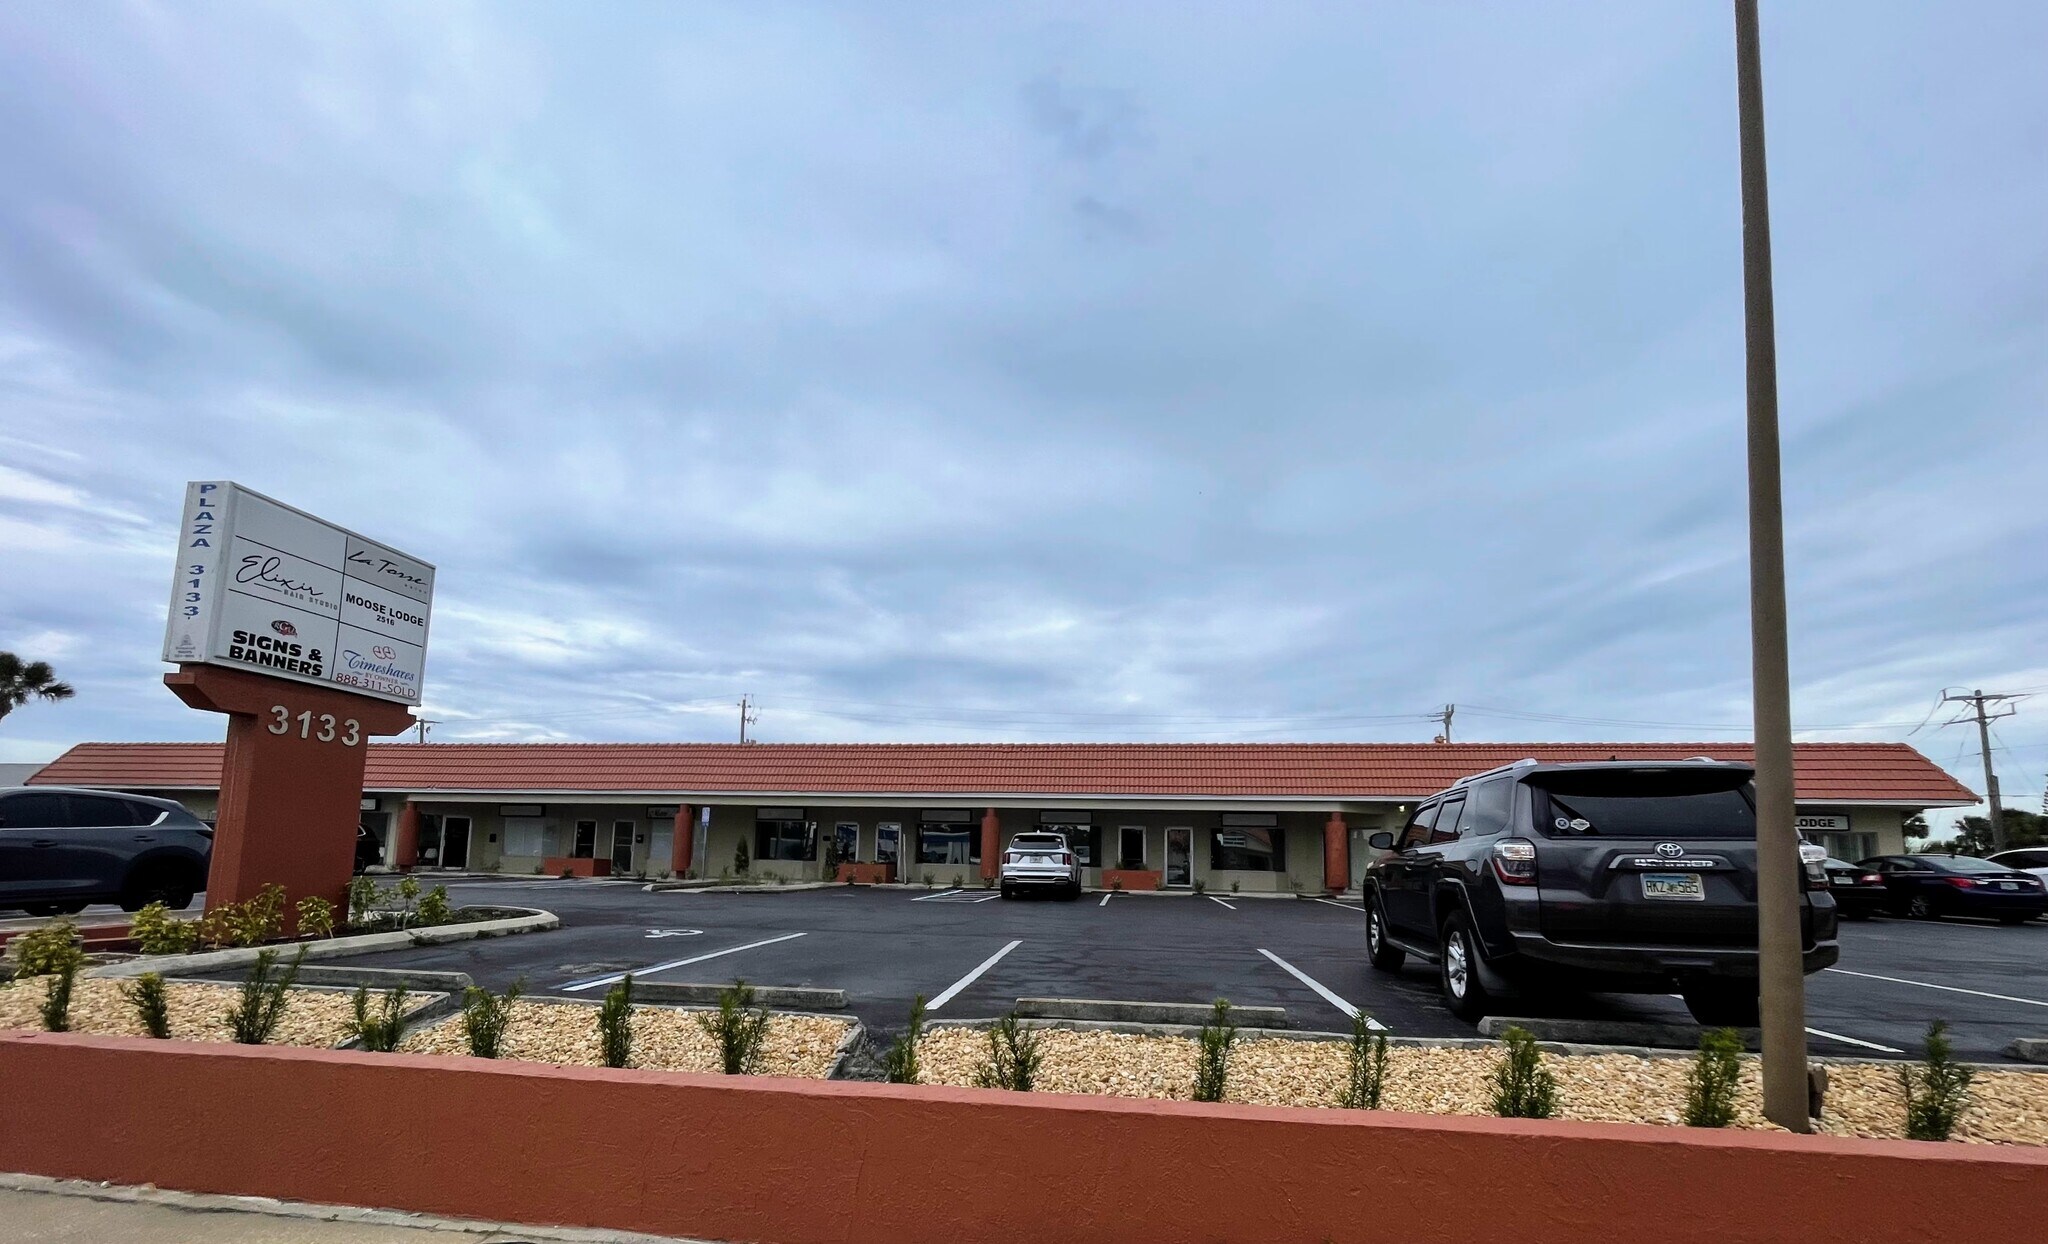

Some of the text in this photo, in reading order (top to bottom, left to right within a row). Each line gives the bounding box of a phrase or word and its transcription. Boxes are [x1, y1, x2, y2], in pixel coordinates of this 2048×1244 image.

[183, 484, 217, 616] PLAZA 3133
[236, 555, 323, 596] Elixir
[283, 589, 338, 611] HAIR STUDIO
[346, 593, 424, 627] MOOSE LODGE
[376, 614, 395, 626] 2516
[229, 645, 323, 676] BANNERS
[233, 630, 322, 662] SIGNS &
[342, 649, 415, 681] Timeshares
[336, 672, 416, 697] 888-311-SOLD
[267, 705, 360, 747] 3133
